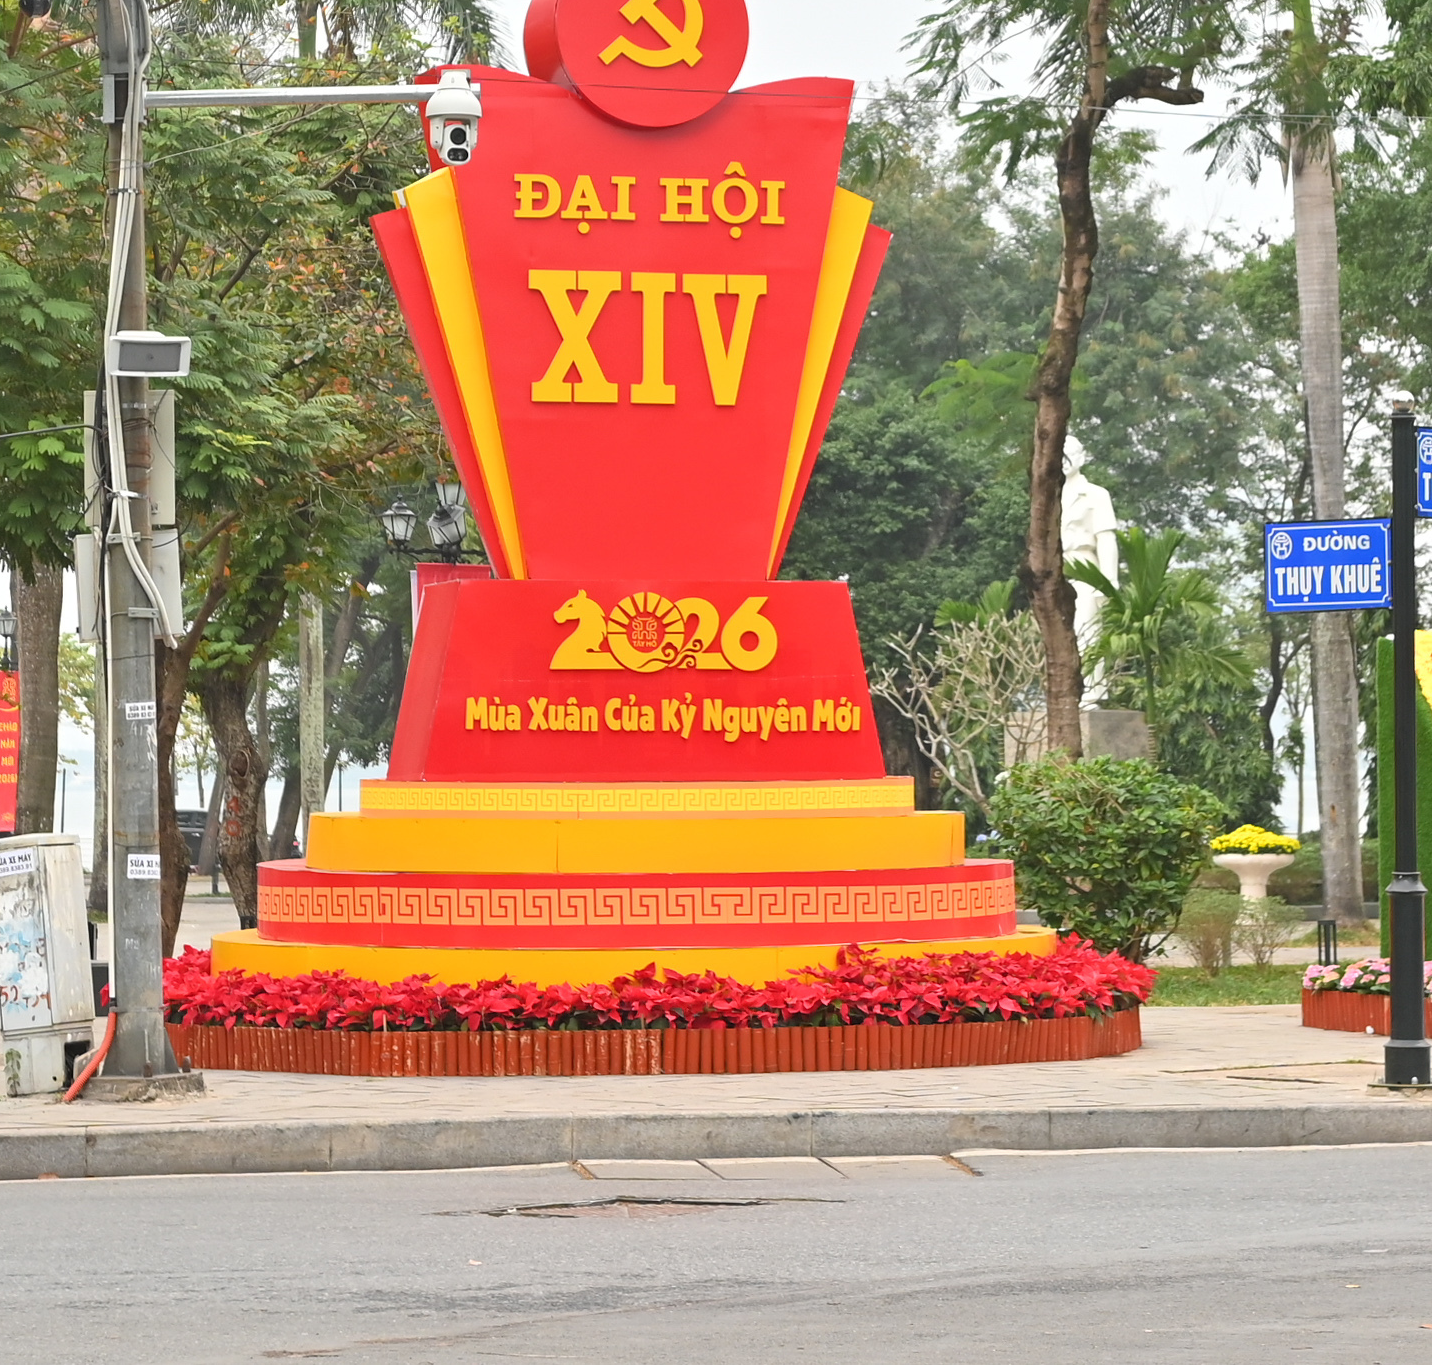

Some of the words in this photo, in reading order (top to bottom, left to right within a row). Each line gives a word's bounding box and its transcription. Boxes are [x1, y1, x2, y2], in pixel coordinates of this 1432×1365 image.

[513, 173, 636, 235] ĐẠI
[659, 160, 786, 239] HỘI
[527, 268, 768, 406] XIV
[1303, 530, 1371, 552] ĐƯỜNG
[1275, 565, 1324, 602] THỤY
[1330, 557, 1382, 594] KHUÊ
[464, 696, 522, 731] Mùa
[527, 696, 599, 731] Xuân
[604, 693, 656, 731] Của
[660, 692, 698, 739] Kỷ
[702, 698, 807, 742] Nguyên
[811, 696, 861, 732] Mới
